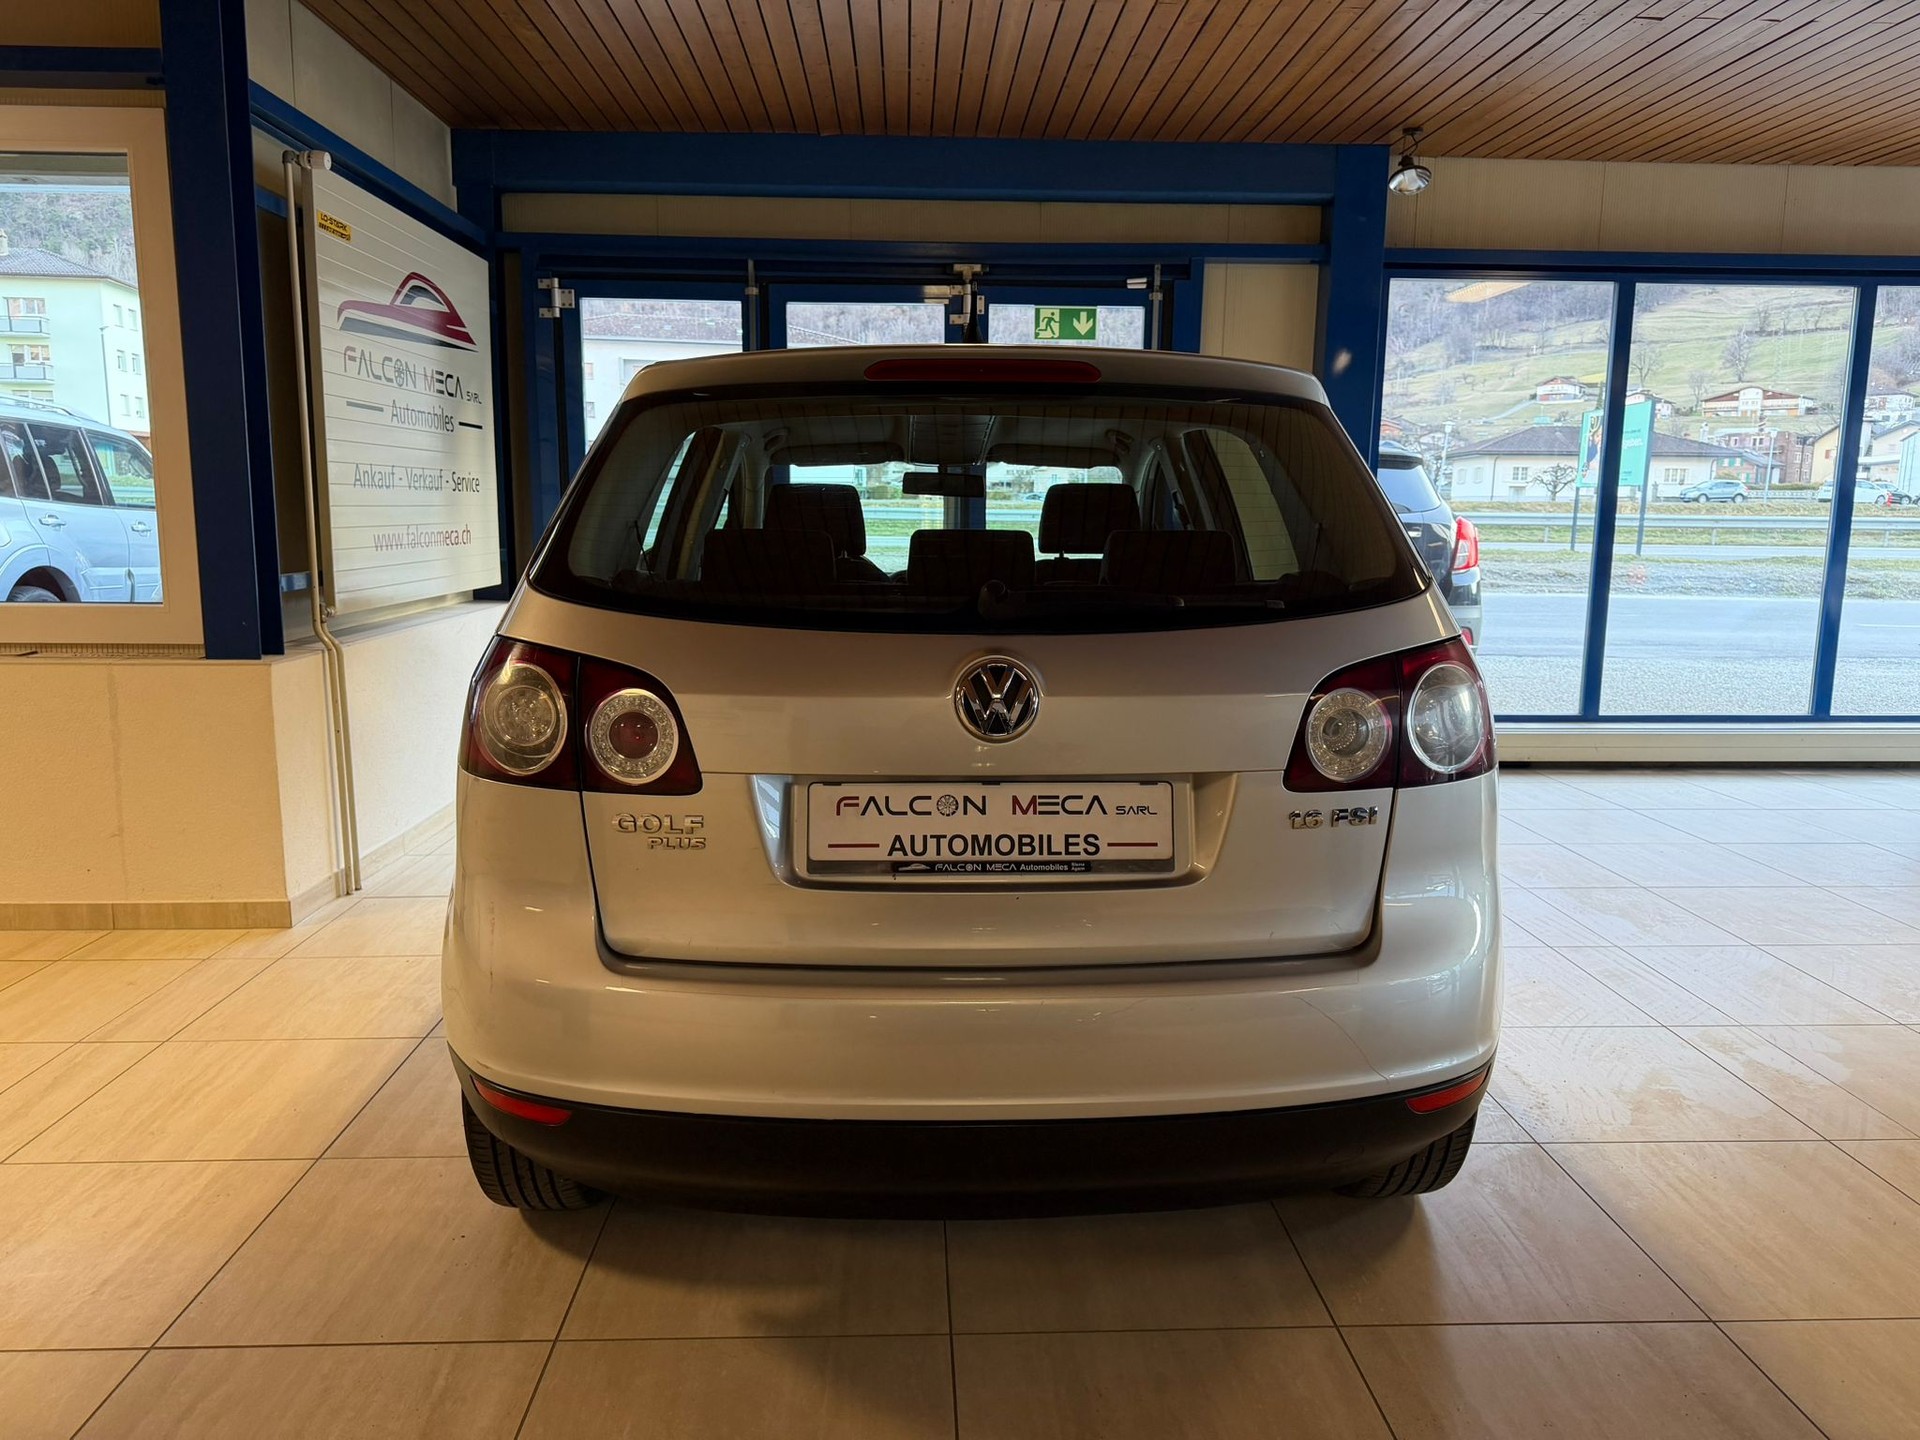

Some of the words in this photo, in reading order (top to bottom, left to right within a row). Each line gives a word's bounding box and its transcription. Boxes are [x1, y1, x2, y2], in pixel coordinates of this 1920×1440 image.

[343, 345, 417, 390] FALCON
[423, 366, 464, 400] MECA
[391, 399, 455, 433] Automobiles
[353, 463, 396, 489] Ankauf
[405, 466, 443, 492] Verkauf
[452, 471, 480, 493] Service
[373, 523, 472, 552] www.falconmeca.ch
[836, 794, 987, 816] FALCON
[1012, 795, 1108, 815] MECA
[1115, 805, 1158, 815] SARL
[612, 813, 704, 834] GOLF
[647, 837, 706, 849] PLUS
[887, 833, 1101, 857] AUTOMOBILES
[935, 863, 982, 871] FALCON
[986, 863, 1017, 871] MECA
[1020, 863, 1069, 871] Automobiles
